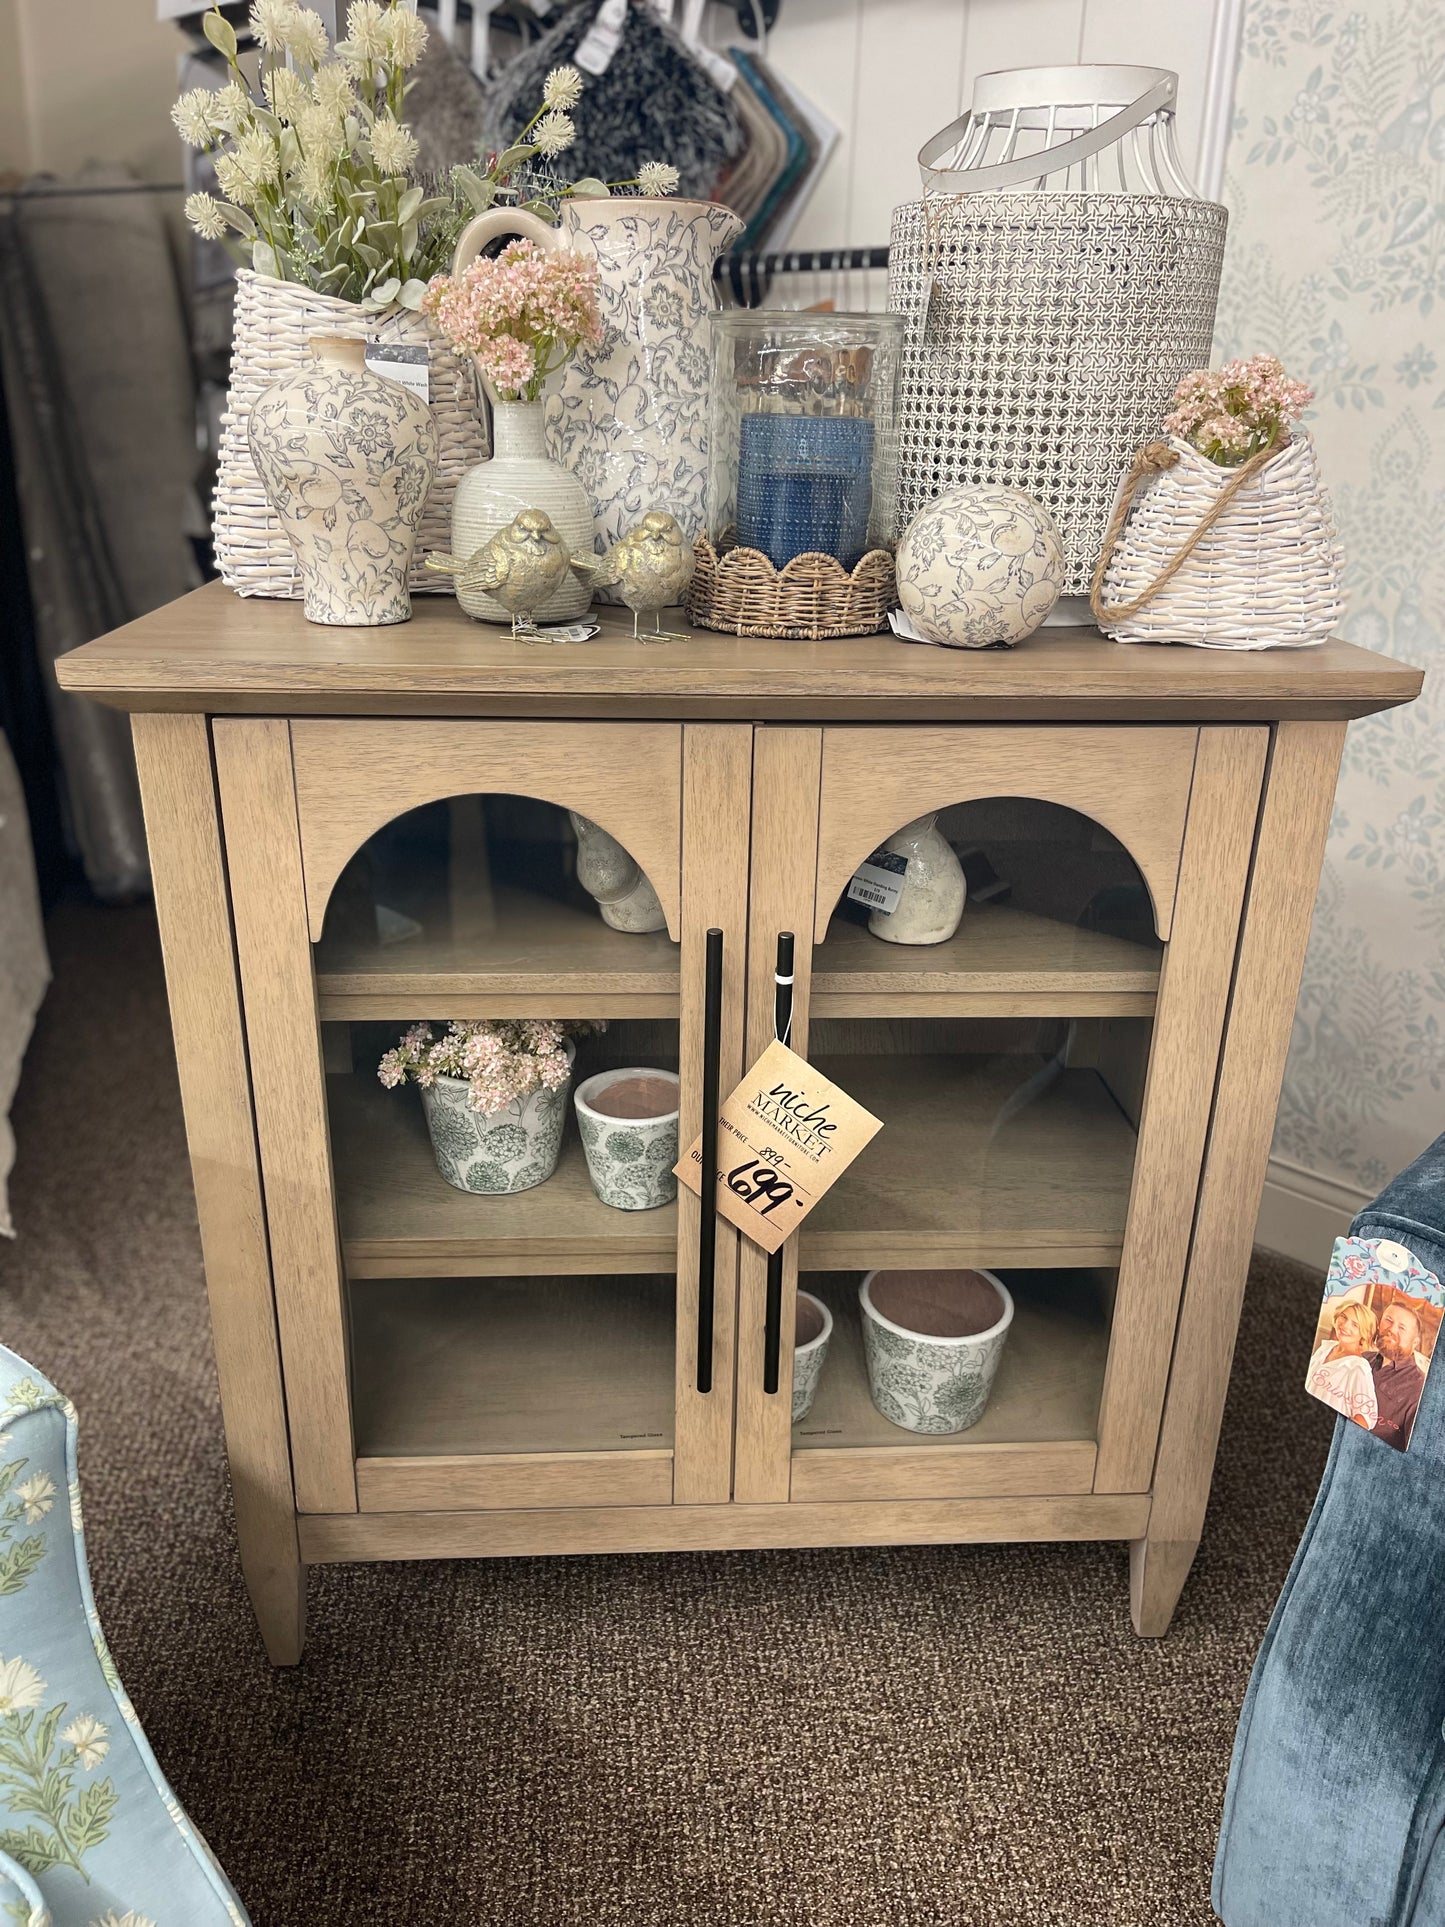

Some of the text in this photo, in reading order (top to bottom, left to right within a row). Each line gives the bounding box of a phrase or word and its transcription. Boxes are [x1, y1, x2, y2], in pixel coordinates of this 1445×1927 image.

[719, 1117, 734, 1132] THEIR
[733, 1129, 749, 1143] PRICE
[751, 1092, 832, 1158] MARKET
[769, 1083, 837, 1139] niche
